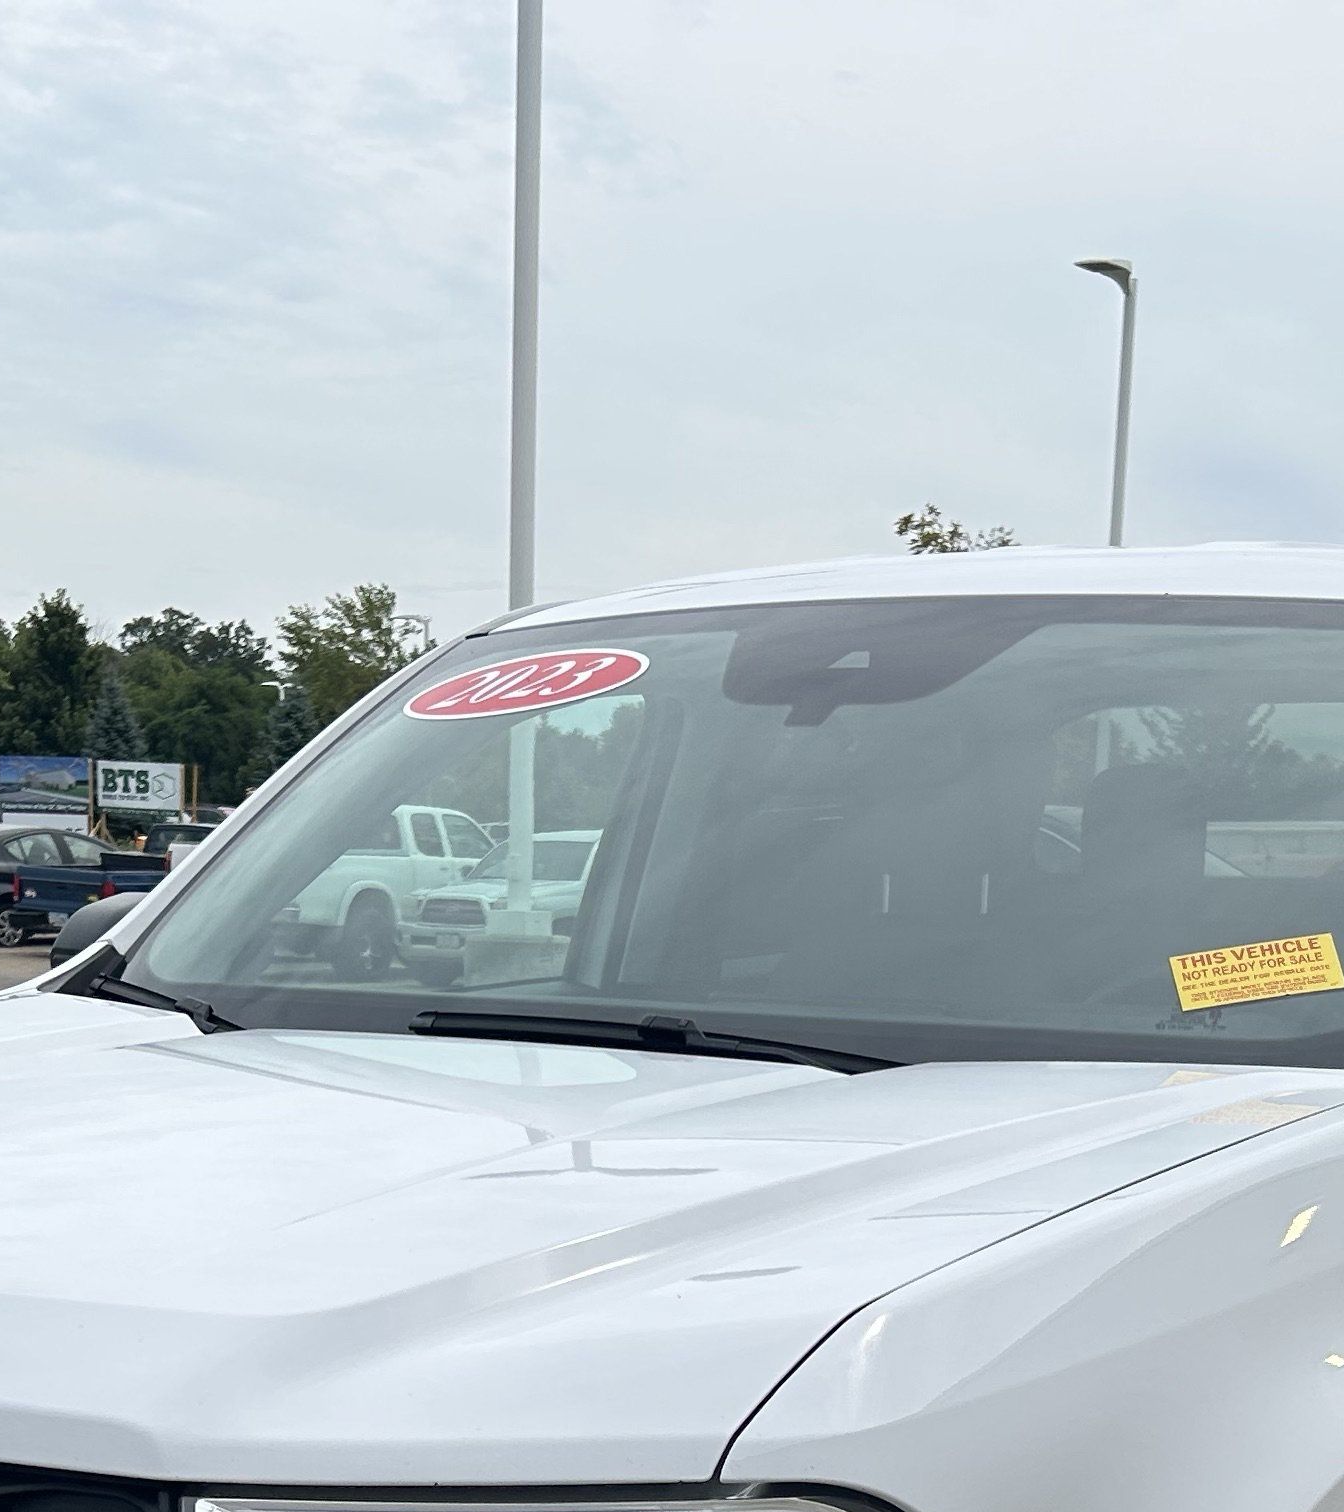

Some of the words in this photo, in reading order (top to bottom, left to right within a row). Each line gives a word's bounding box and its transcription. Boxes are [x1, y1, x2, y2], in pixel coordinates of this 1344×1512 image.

[426, 656, 617, 711] 2023
[101, 768, 150, 793] BTS
[1177, 952, 1226, 970] THIS
[1229, 937, 1321, 961] VEHICLE
[1181, 970, 1209, 982] NOT
[1212, 961, 1256, 978] READY
[1259, 957, 1286, 970] FOR
[1288, 952, 1324, 966] SALE
